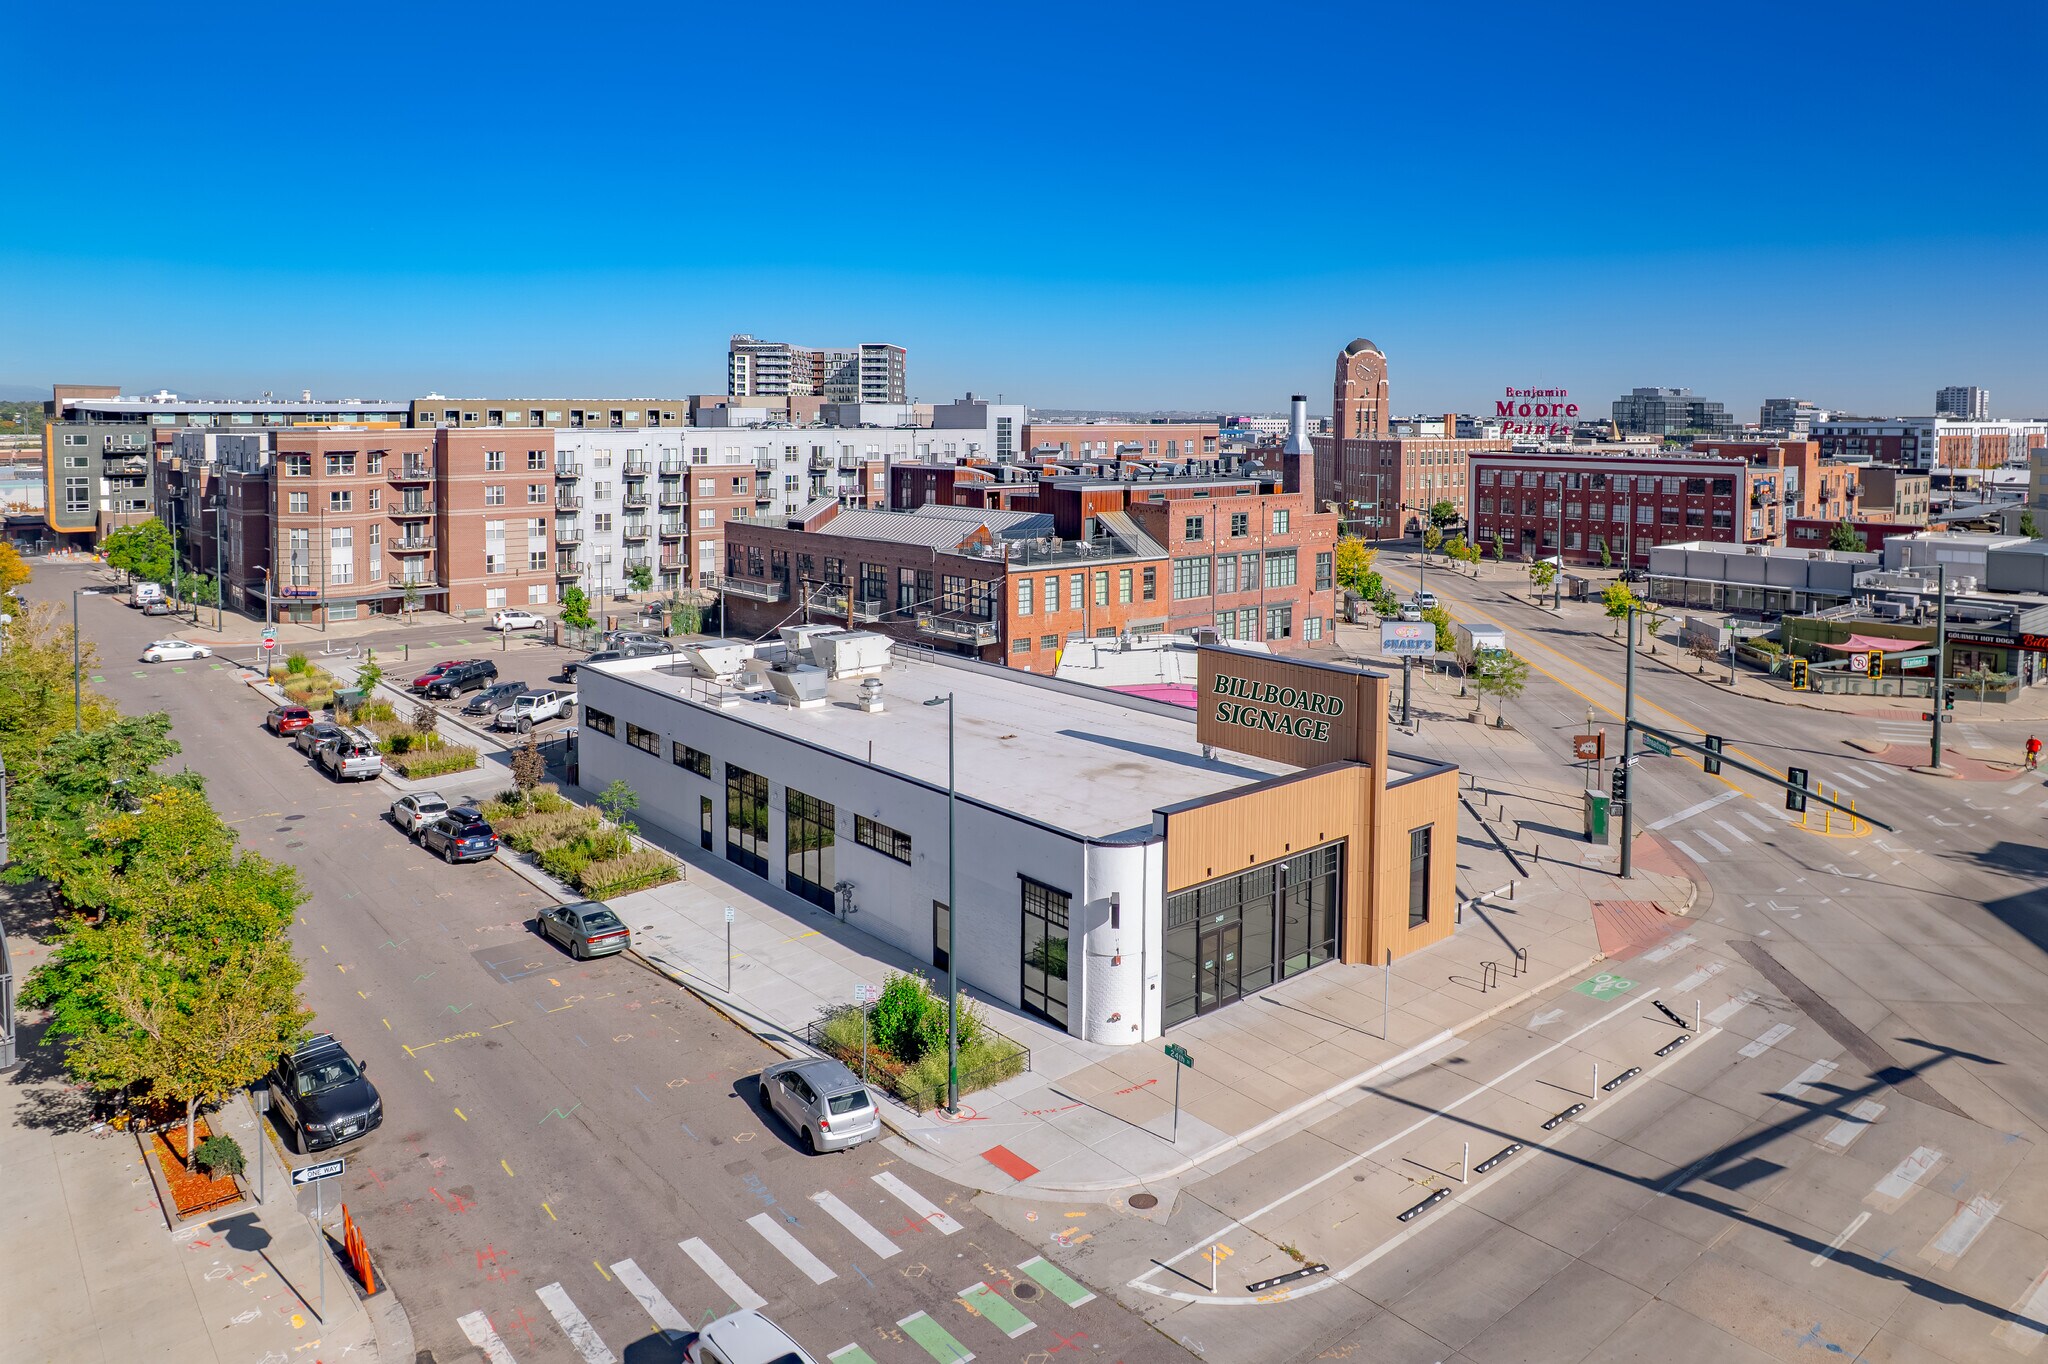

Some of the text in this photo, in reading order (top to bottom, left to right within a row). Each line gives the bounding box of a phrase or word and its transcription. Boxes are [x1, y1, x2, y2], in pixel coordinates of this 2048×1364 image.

[1506, 386, 1568, 399] Benjamin
[1495, 400, 1579, 417] Moore
[1500, 420, 1571, 435] Paints
[1948, 632, 1979, 641] GOURMET
[1995, 637, 2015, 645] DOGS
[2023, 634, 2048, 647] Bill
[1213, 673, 1345, 717] BILLBOARD
[1215, 701, 1330, 742] SIGNAGE
[1170, 1050, 1186, 1064] 24th
[324, 1164, 338, 1173] WAY
